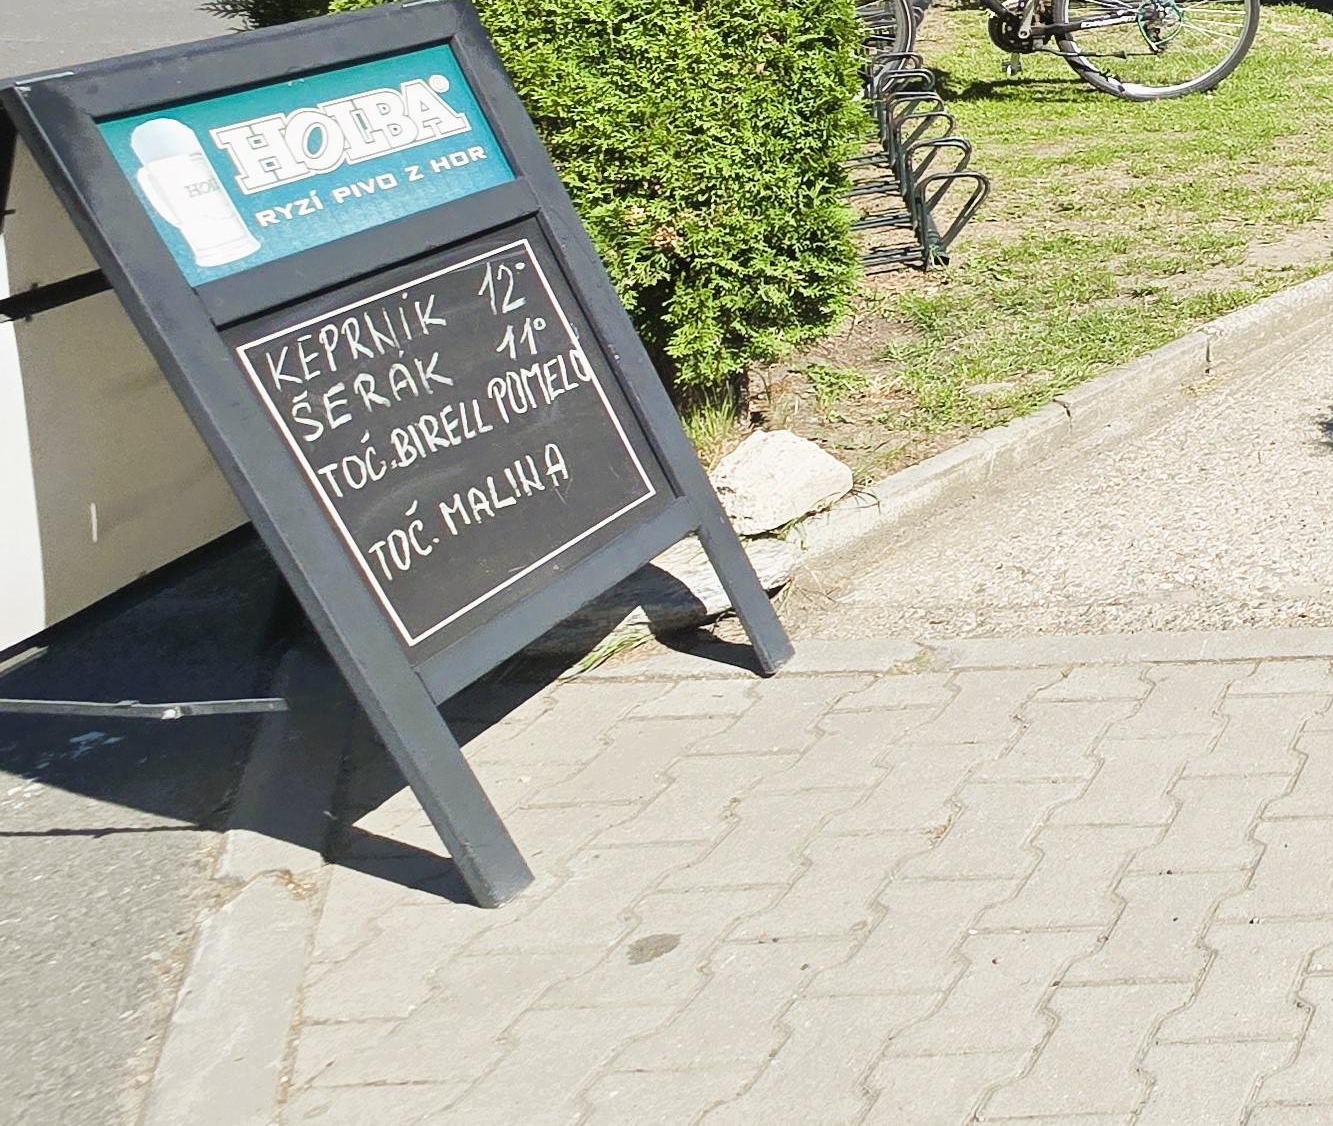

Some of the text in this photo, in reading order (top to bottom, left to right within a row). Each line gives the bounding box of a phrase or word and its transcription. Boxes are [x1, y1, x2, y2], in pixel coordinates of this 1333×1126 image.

[209, 78, 472, 196] HOLBA
[255, 145, 489, 227] RYZÍ PIVO Z HOR
[439, 443, 570, 536] MALINA
